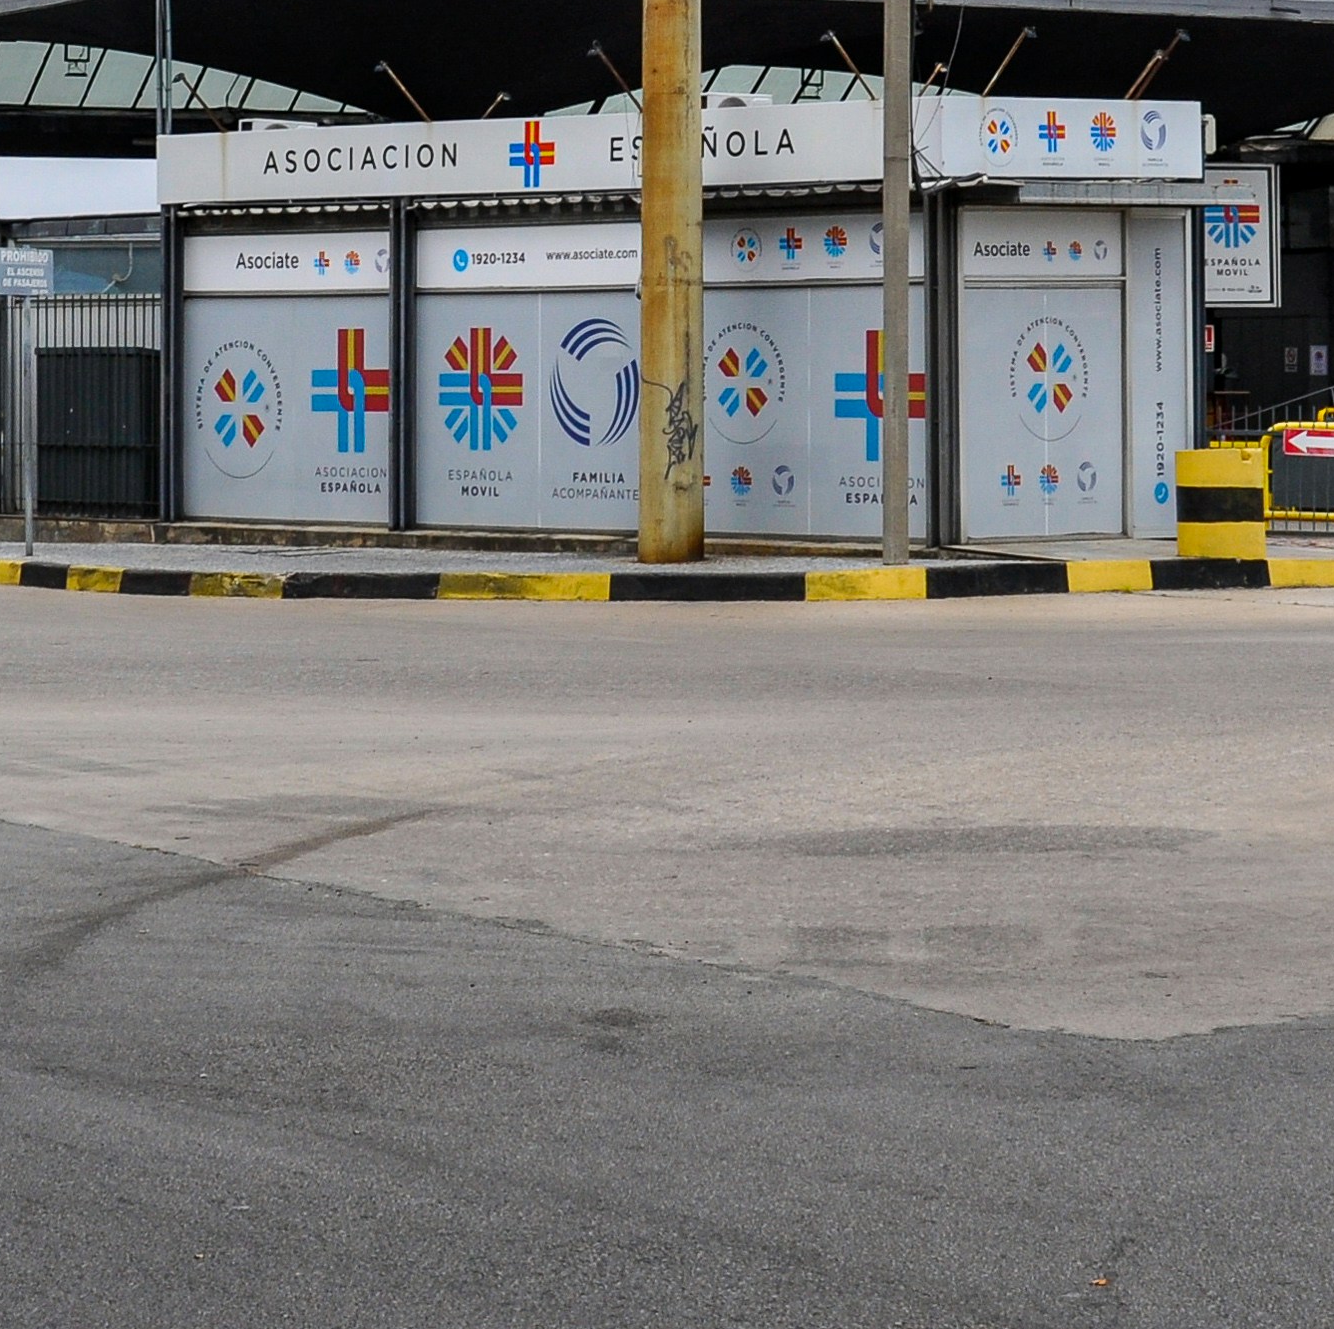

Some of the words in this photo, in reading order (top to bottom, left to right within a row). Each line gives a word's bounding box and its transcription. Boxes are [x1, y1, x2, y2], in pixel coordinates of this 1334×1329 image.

[263, 142, 458, 175] ASOCIACION
[610, 125, 795, 162] ESÑOLA
[1, 250, 49, 262] PROHIBIDO
[545, 248, 638, 261] www.asociate.com
[973, 241, 1031, 257] Asociate
[235, 251, 300, 270] Asociate
[471, 252, 526, 265] 1920-1234
[1216, 269, 1249, 277] MOVIL
[2, 278, 12, 287] DE
[1154, 247, 1163, 372] www.asociate.com
[719, 322, 757, 339] ATENCION
[1027, 316, 1063, 332] ATENCION
[215, 340, 255, 359] ATENCION
[1156, 401, 1165, 477] 1920-1234
[315, 467, 387, 478] ASOCIACION
[448, 468, 513, 482] ESPAÑOLA
[572, 472, 625, 484] FAMILIA
[321, 479, 381, 493] ESPAÑOLA
[461, 486, 500, 497] MOVIL
[551, 486, 639, 501] ACOMPAÑANTE
